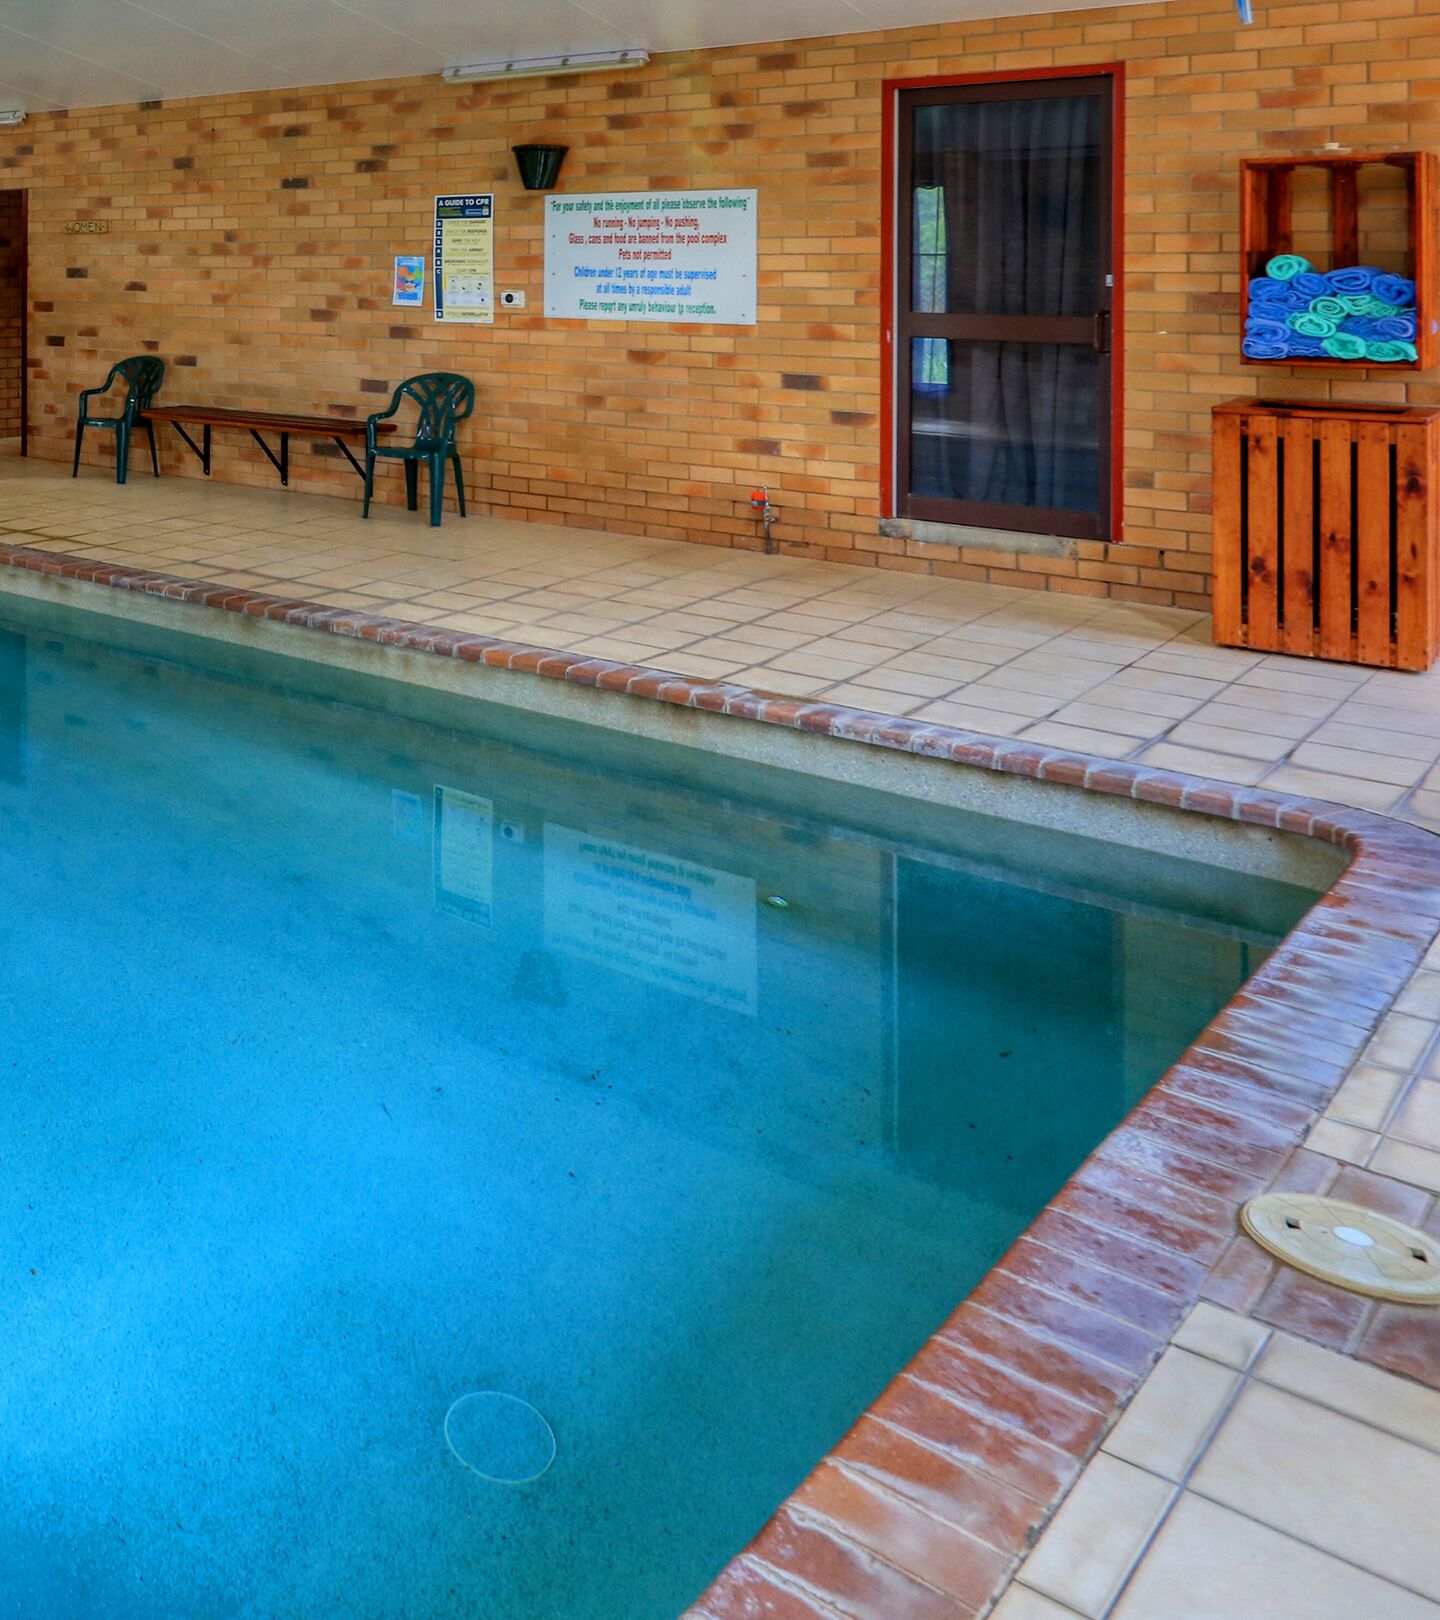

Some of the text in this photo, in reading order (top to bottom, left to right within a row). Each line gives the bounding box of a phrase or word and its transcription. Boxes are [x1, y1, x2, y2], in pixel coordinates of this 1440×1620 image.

[563, 203, 574, 213] your
[576, 200, 592, 213] safety
[594, 200, 603, 211] and
[605, 200, 614, 210] the
[616, 199, 644, 213] enjoyment
[646, 198, 653, 210] of
[662, 198, 680, 212] please
[707, 197, 717, 208] the
[593, 216, 601, 228] No
[603, 216, 624, 230] running
[628, 216, 636, 227] No
[637, 216, 660, 230] jumping
[665, 216, 673, 227] No
[588, 235, 601, 244] cans
[603, 233, 613, 244] and
[614, 232, 626, 244] food
[628, 235, 637, 244] are
[639, 232, 659, 244] banned
[660, 232, 674, 244] from
[675, 232, 685, 244] the
[687, 232, 700, 246] pool
[701, 232, 727, 246] complex
[619, 248, 672, 262] Pets not permitted
[574, 266, 717, 282] Children under 12 years of age must be supervised
[596, 284, 602, 294] at
[612, 284, 627, 294] times
[628, 284, 635, 297] by
[641, 284, 674, 297] responsible
[676, 284, 691, 296] adult
[579, 299, 598, 311] Please
[617, 302, 627, 314] any
[628, 301, 646, 314] unruly
[647, 301, 676, 313] behaviour
